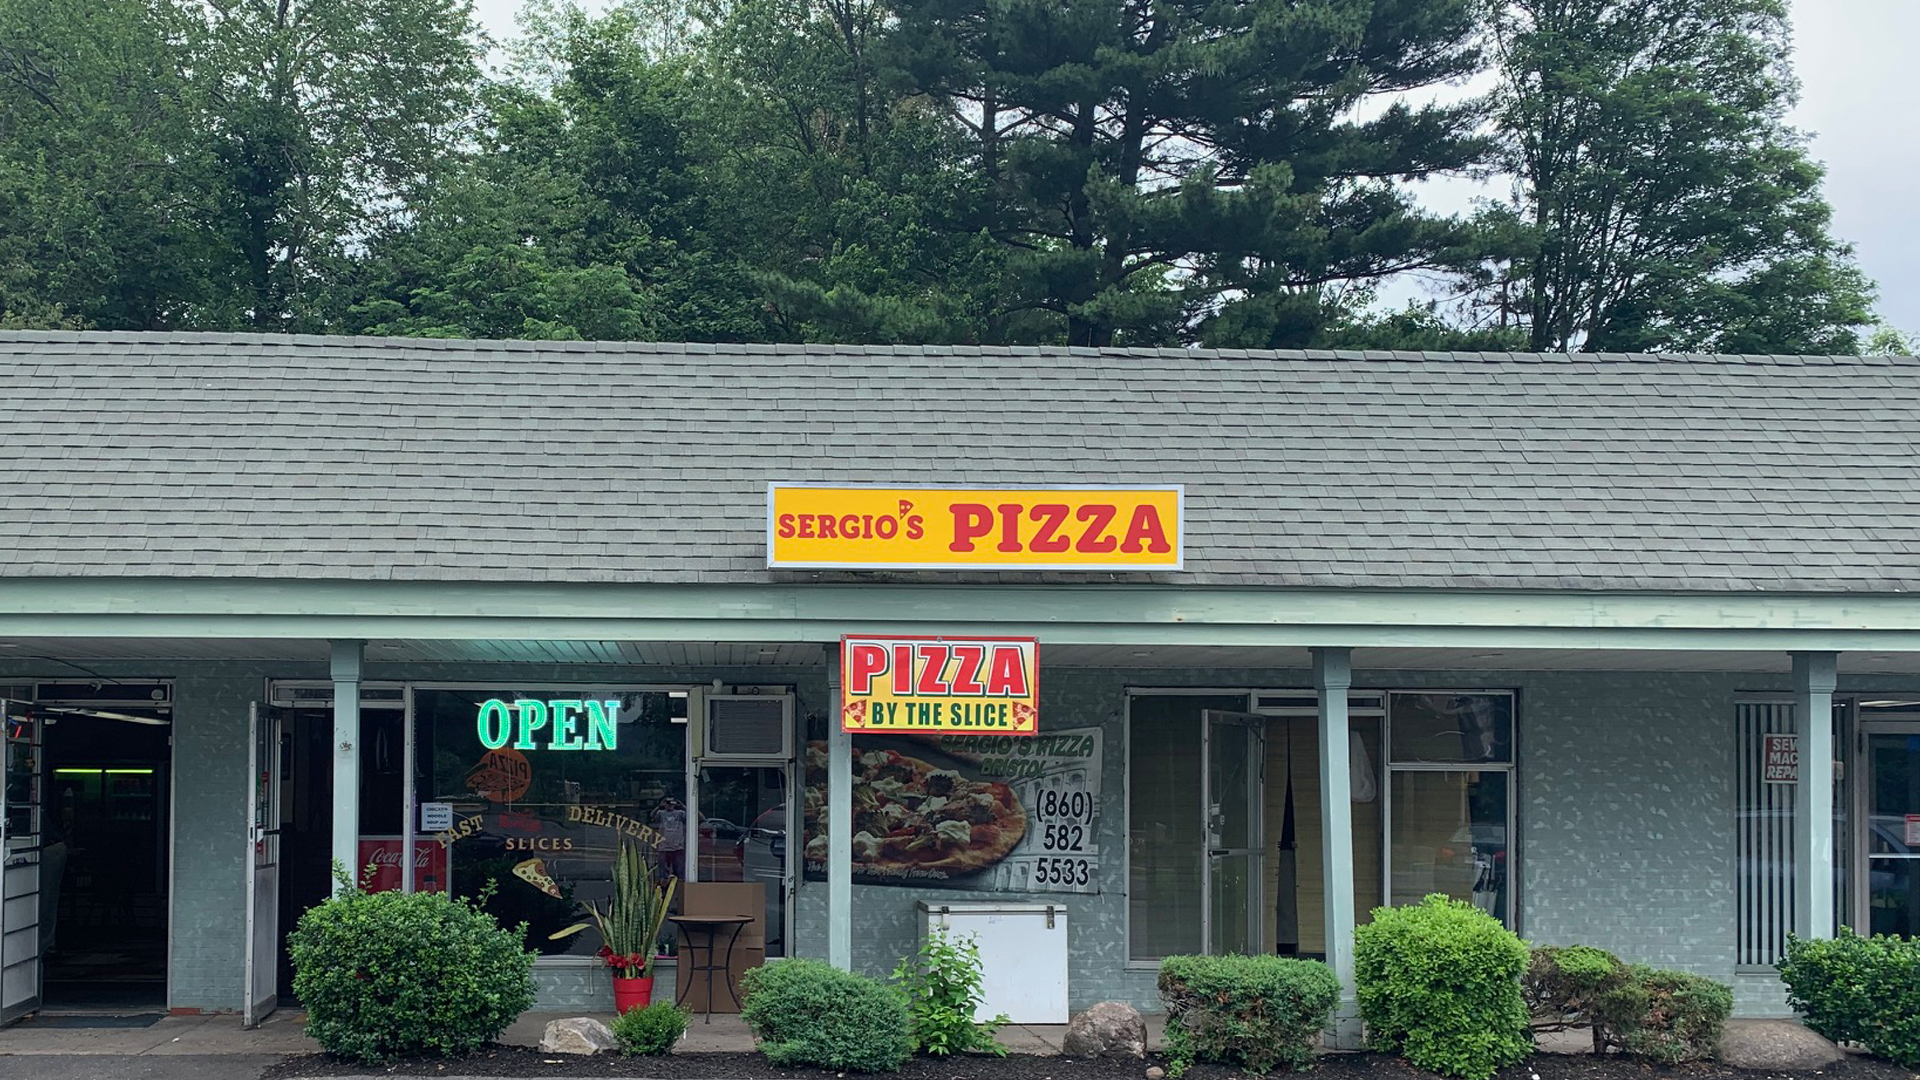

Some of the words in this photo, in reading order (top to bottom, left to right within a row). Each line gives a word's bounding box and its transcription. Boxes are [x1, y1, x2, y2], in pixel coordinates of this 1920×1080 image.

[948, 503, 1172, 554] PIZZA
[849, 642, 1031, 698] PIZZA
[477, 698, 621, 751] OPEN
[871, 703, 896, 725] BY
[905, 702, 943, 726] THE
[950, 703, 1008, 727] SLICE
[940, 735, 1032, 757] SERGIO'S
[1036, 735, 1095, 758] PIZZA
[1773, 738, 1798, 751] SEW
[979, 758, 1048, 778] BRISTOL
[1766, 765, 1797, 779] REPA
[1036, 789, 1093, 825] (860)
[437, 814, 483, 849] FAST
[568, 805, 667, 849] DELIVERY
[1043, 824, 1083, 851] 582
[505, 837, 573, 850] SLICES
[1035, 857, 1089, 886] 5533
